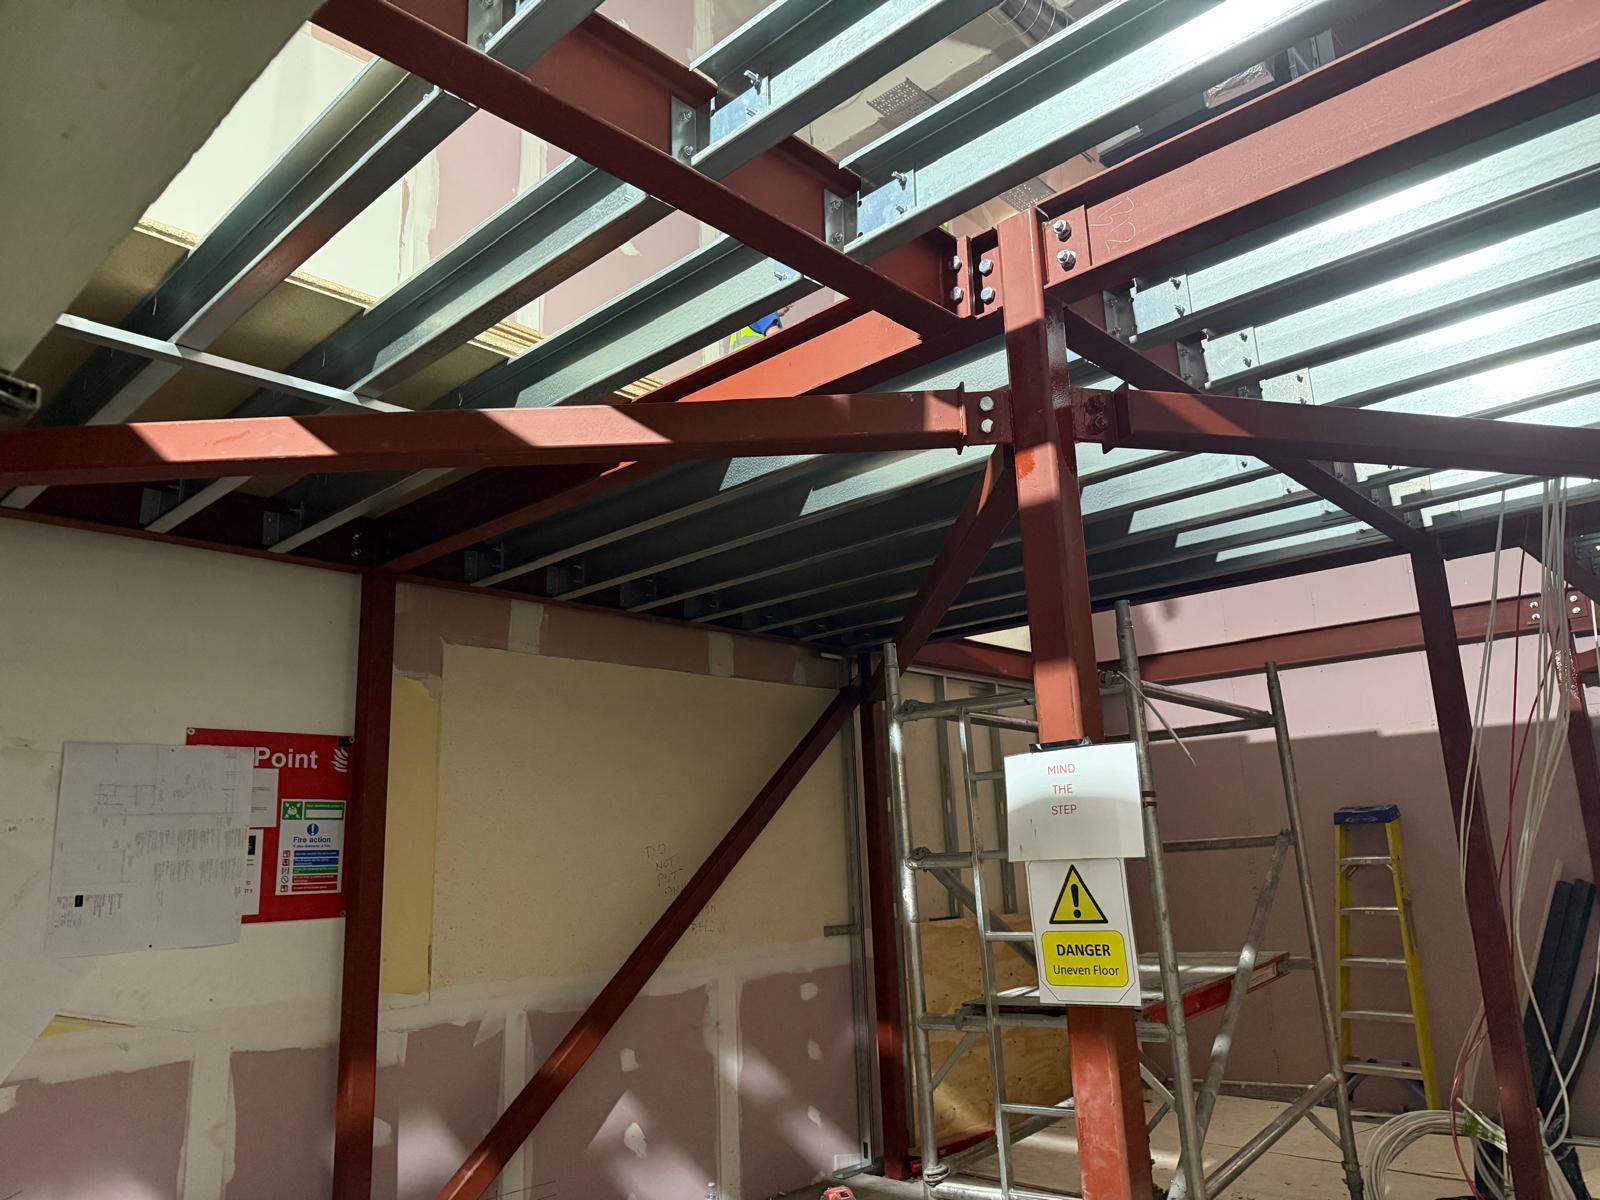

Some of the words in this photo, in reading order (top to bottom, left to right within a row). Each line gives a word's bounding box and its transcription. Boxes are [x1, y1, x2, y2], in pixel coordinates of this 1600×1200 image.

[254, 746, 318, 769] Point
[1047, 763, 1076, 775] MIND
[1052, 783, 1073, 795] THE
[1051, 804, 1077, 815] STEP
[1056, 943, 1111, 957] DANGER
[1053, 964, 1091, 975] Uneven
[1093, 965, 1119, 976] Floor
